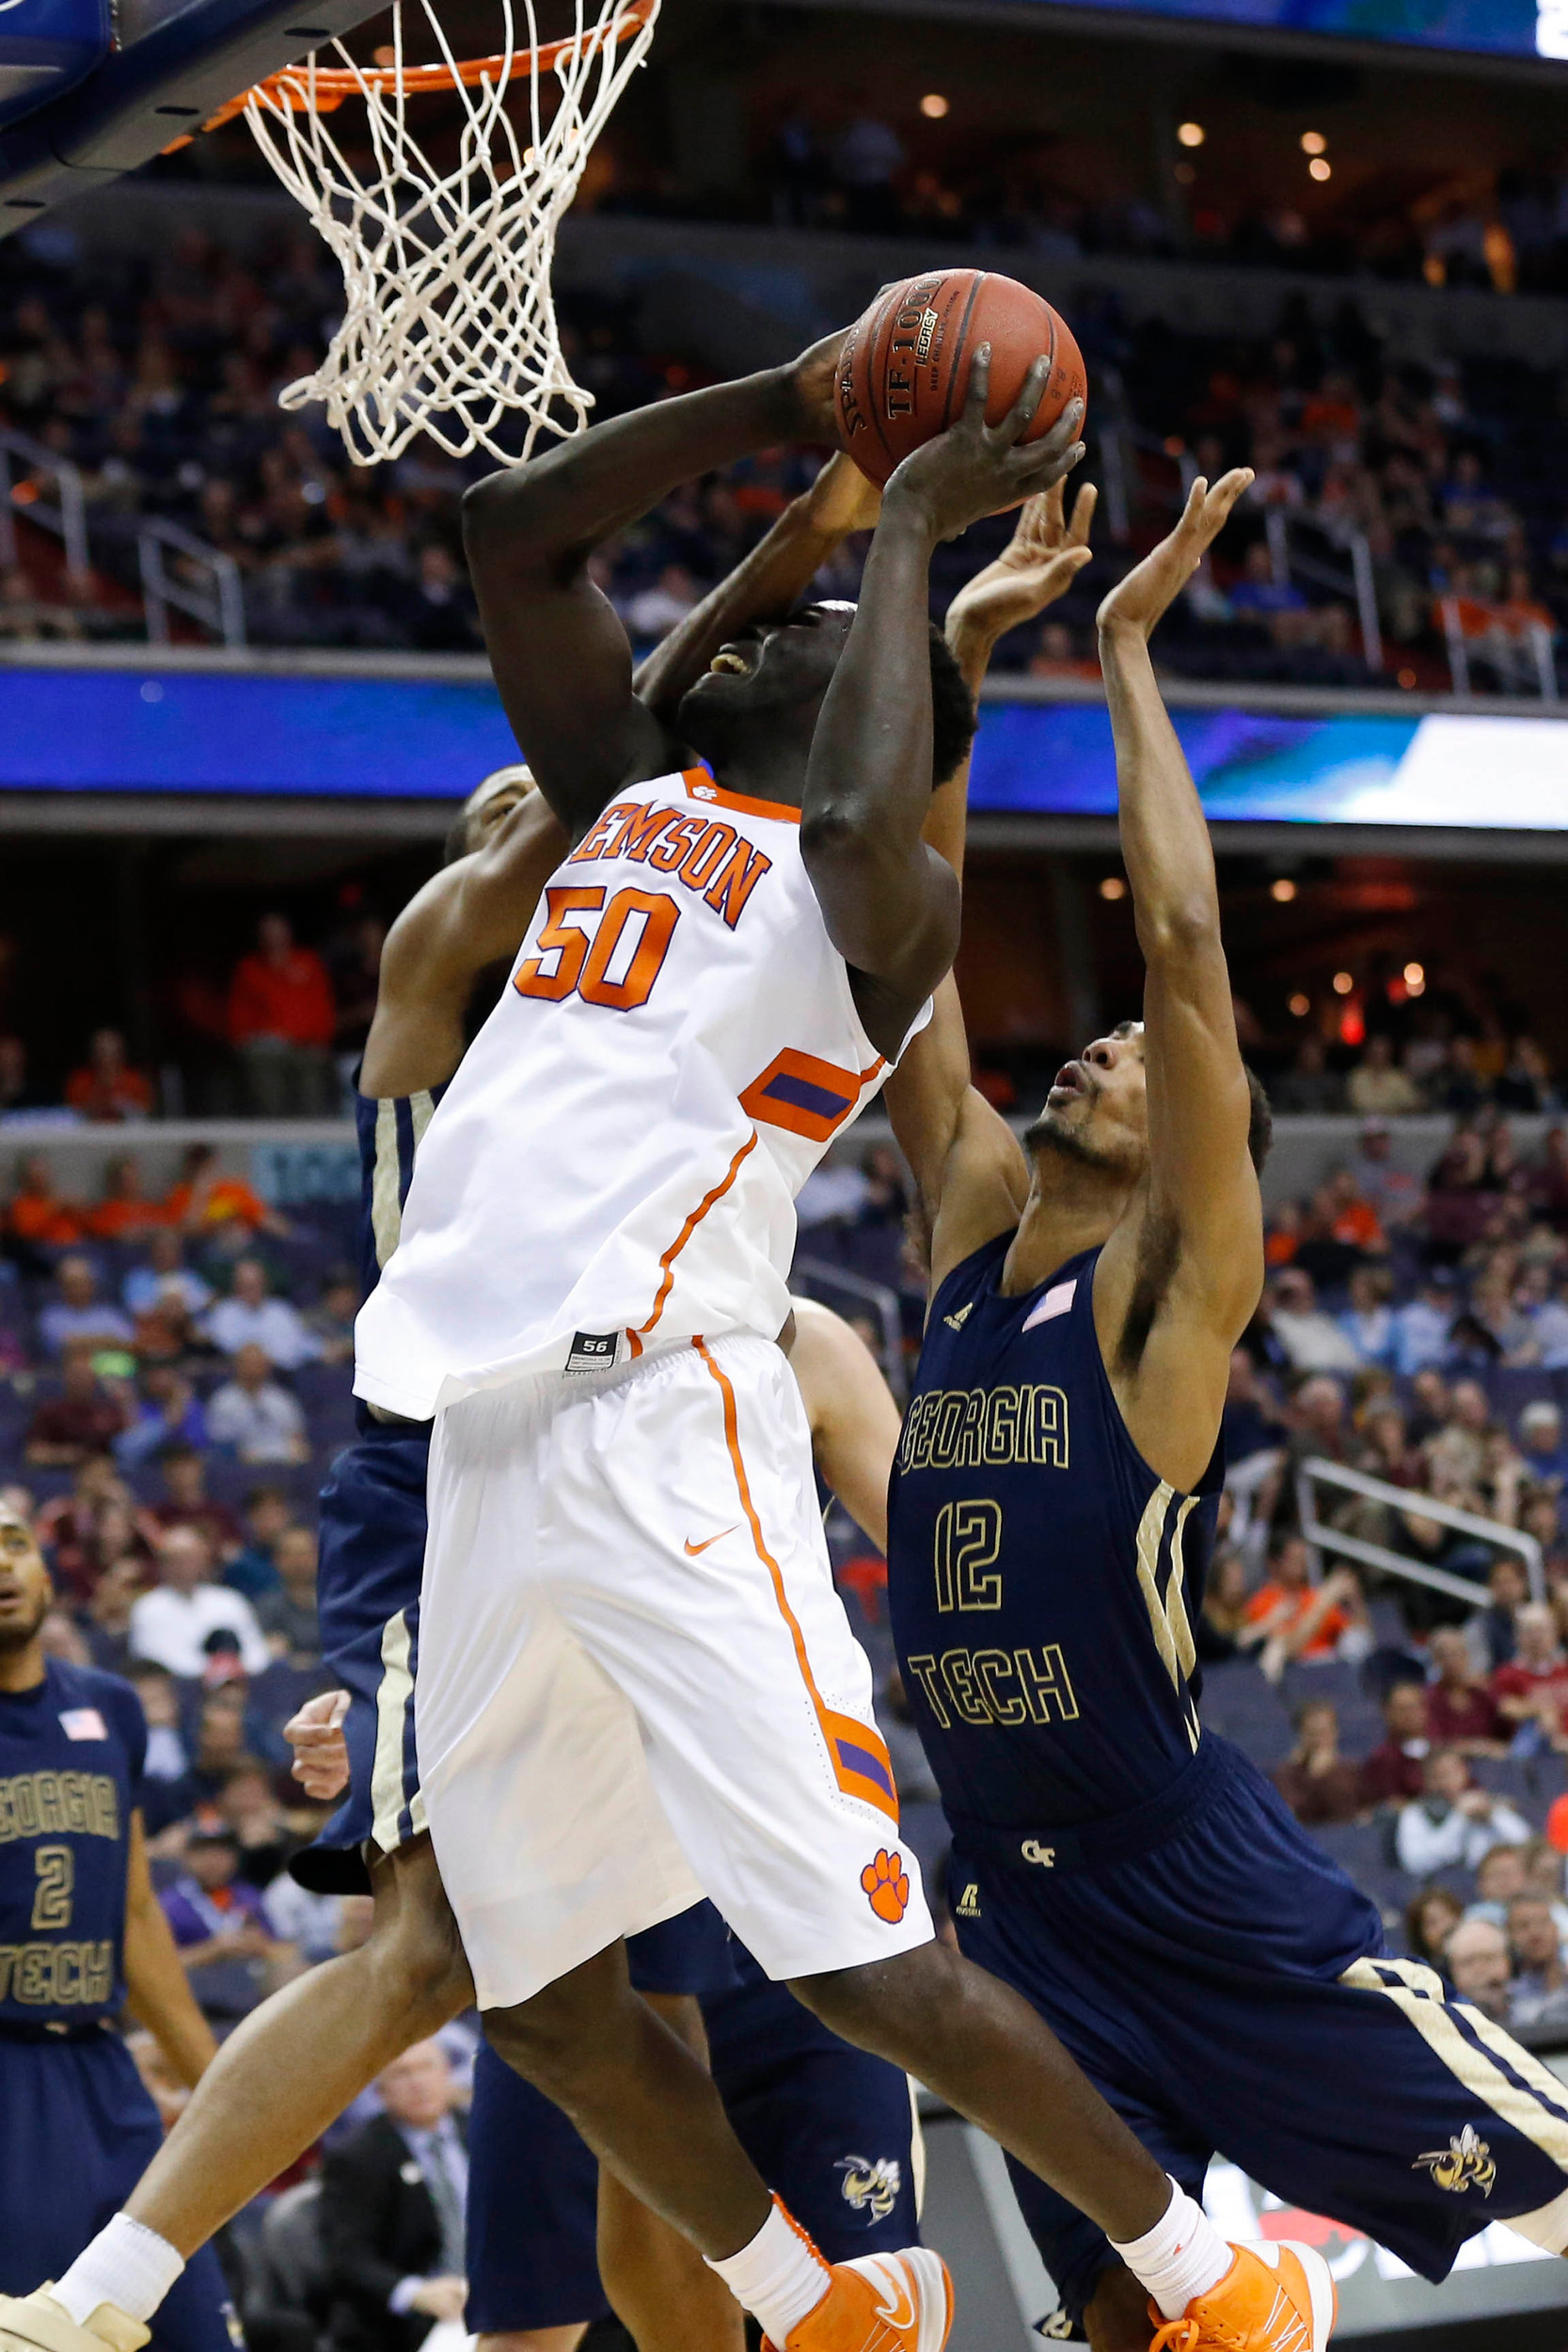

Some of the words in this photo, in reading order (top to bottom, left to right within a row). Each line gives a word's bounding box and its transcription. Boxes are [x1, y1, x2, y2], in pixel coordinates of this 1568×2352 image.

[914, 307, 939, 367] LEGACY
[513, 886, 682, 1012] 50
[583, 1341, 609, 1353] 56
[899, 1384, 1069, 1476] GEORGIA
[935, 1499, 1002, 1613] 12
[908, 1644, 1080, 1728] TECH
[31, 1844, 73, 1930] 2
[0, 1940, 112, 2005] TECH
